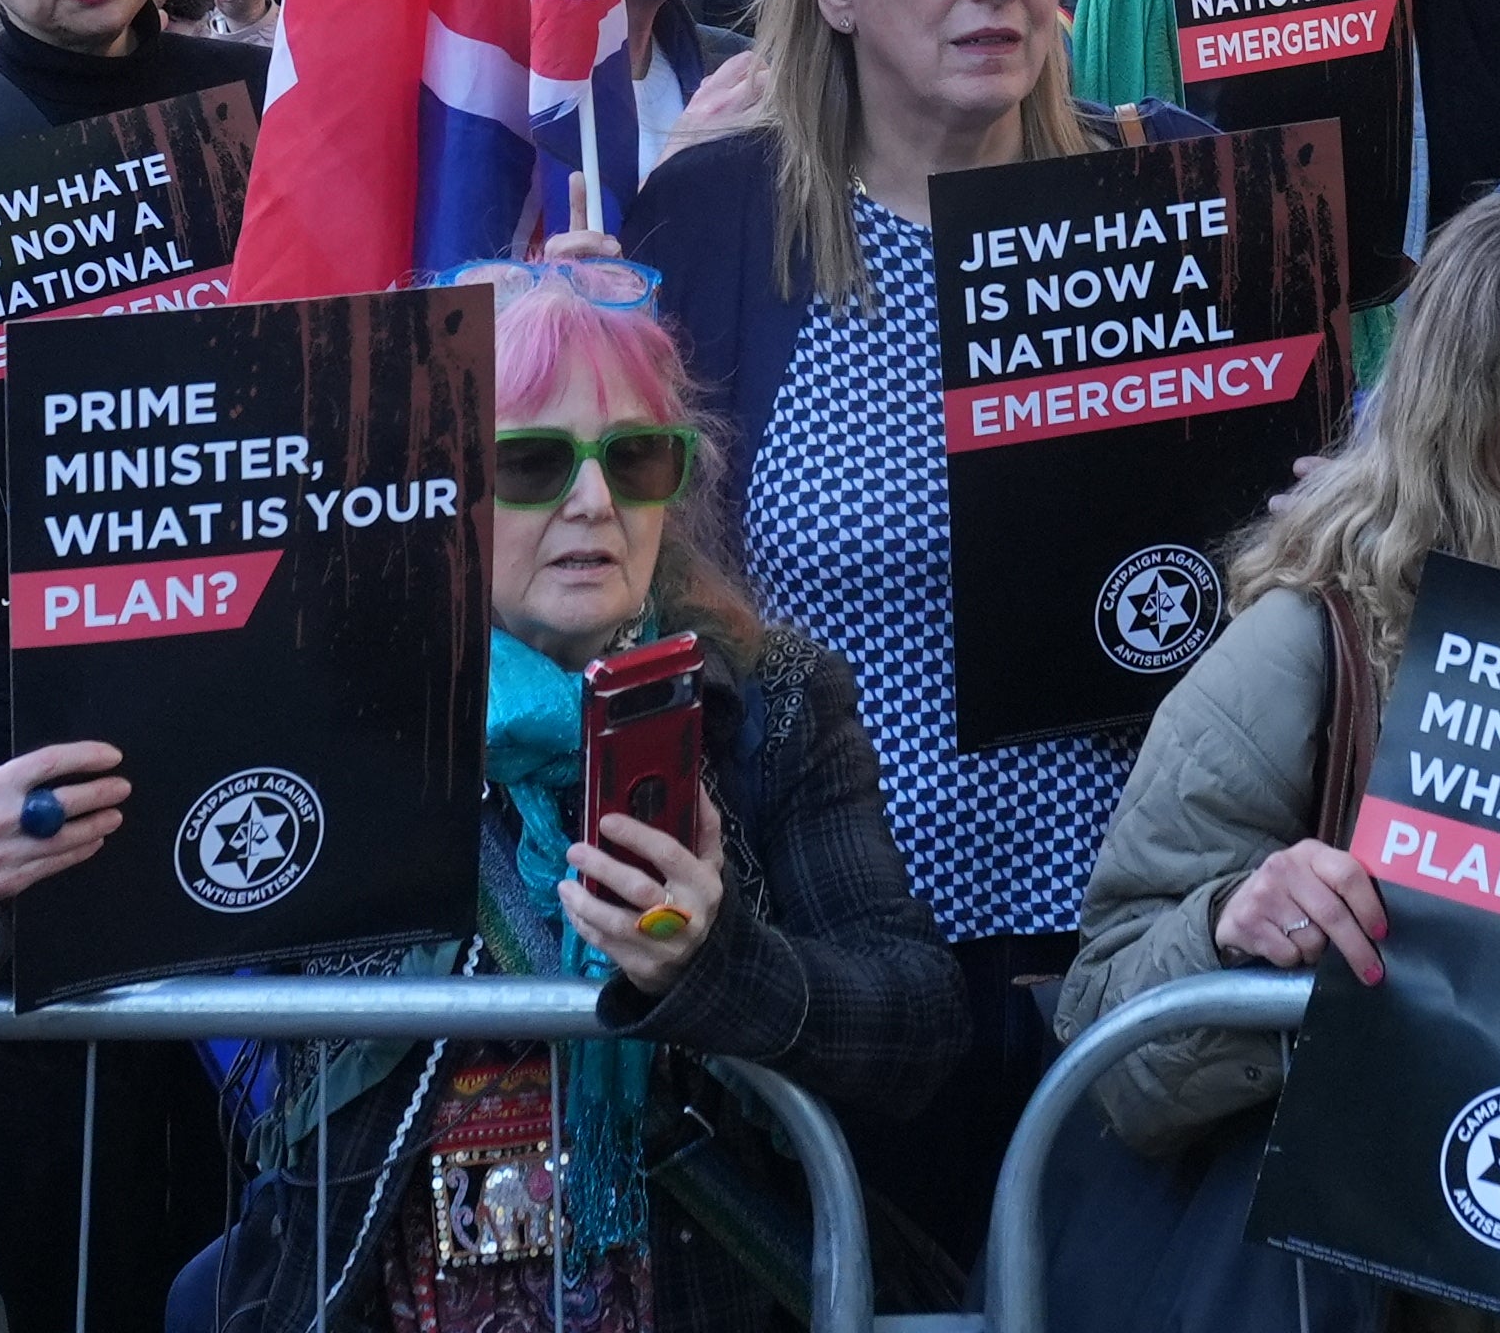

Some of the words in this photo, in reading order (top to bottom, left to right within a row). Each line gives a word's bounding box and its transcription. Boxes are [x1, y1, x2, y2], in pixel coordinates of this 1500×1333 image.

[1196, 10, 1379, 70] EMERGENCY
[13, 212, 120, 265] NOW
[133, 201, 164, 235] A
[959, 197, 1229, 272] JEW-HATE
[963, 283, 1009, 326] IS
[1026, 262, 1156, 312] NOW
[1172, 255, 1209, 292] A
[968, 306, 1235, 380] NATIONAL
[43, 381, 217, 436] PRIME
[970, 352, 1285, 438] EMERGENCY
[44, 434, 325, 497] MINISTER,
[45, 501, 221, 558] WHAT
[241, 498, 287, 540] IS
[306, 478, 458, 534] YOUR
[42, 571, 239, 631] PLAN?
[1103, 552, 1162, 612] CAMPAIGN
[1164, 551, 1214, 592] AGAINST
[1114, 628, 1206, 667] ANTISEMITISM
[185, 775, 259, 842] CAMPAIGN
[262, 776, 316, 824] AGAINST
[193, 861, 301, 906] ANTISEMITISM
